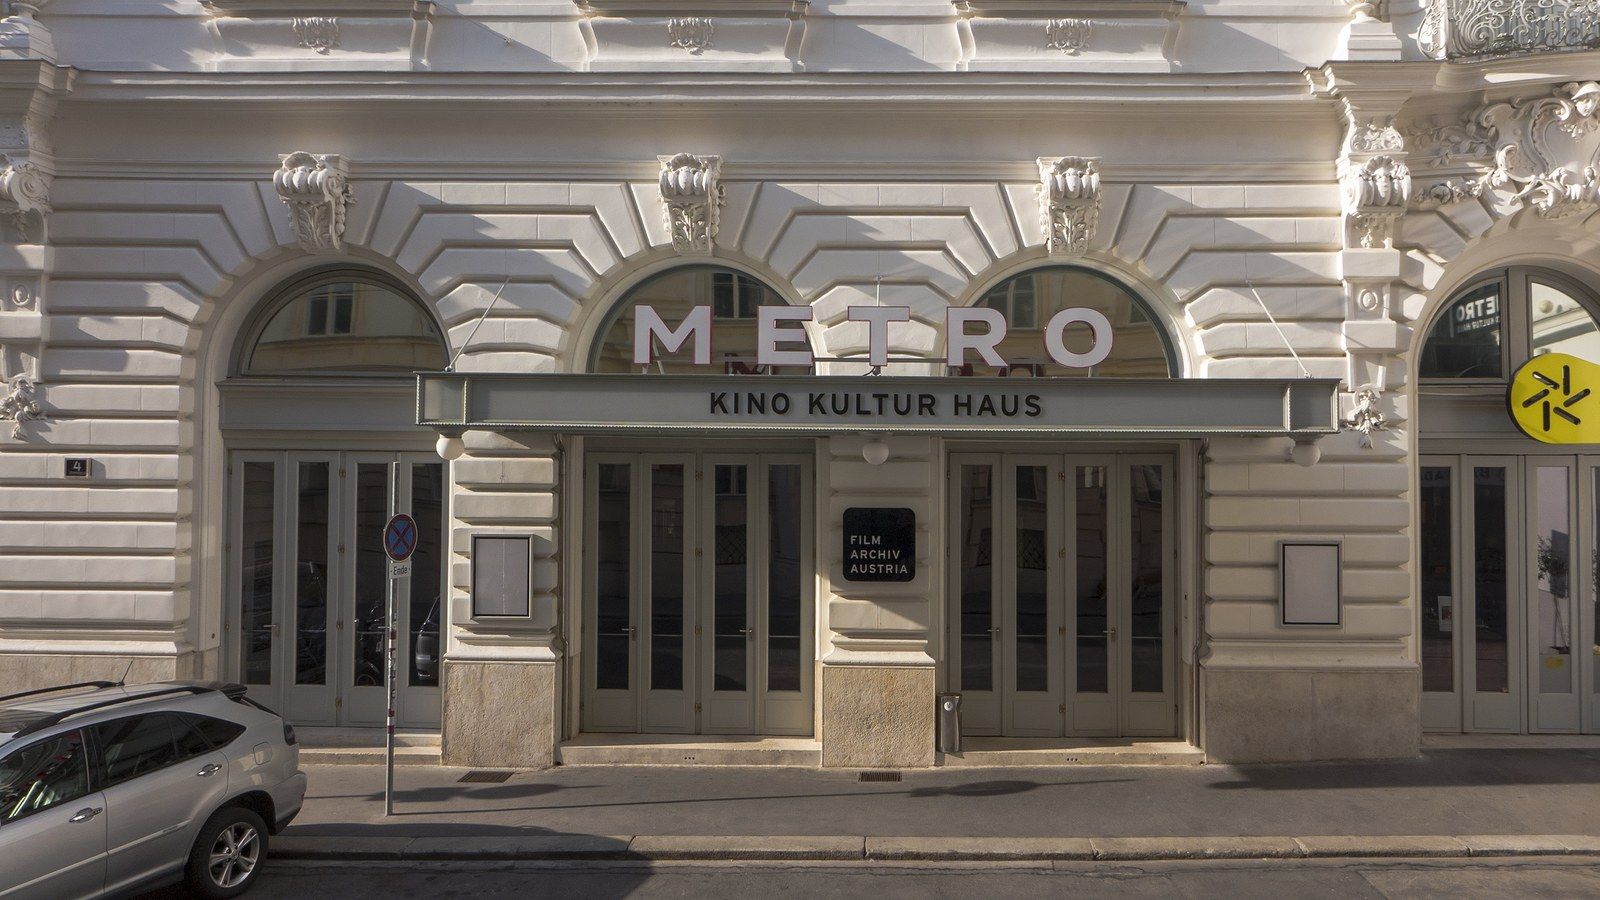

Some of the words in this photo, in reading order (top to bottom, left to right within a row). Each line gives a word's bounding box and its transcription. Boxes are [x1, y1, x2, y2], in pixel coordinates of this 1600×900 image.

[633, 305, 1114, 368] METRO
[711, 392, 790, 415] KINO
[809, 393, 936, 416] KULTUR
[953, 394, 1042, 417] HAUS
[73, 461, 82, 472] 4
[850, 535, 881, 545] FILM
[850, 550, 901, 559] ARCHIV
[850, 564, 908, 574] AUSTRIA
